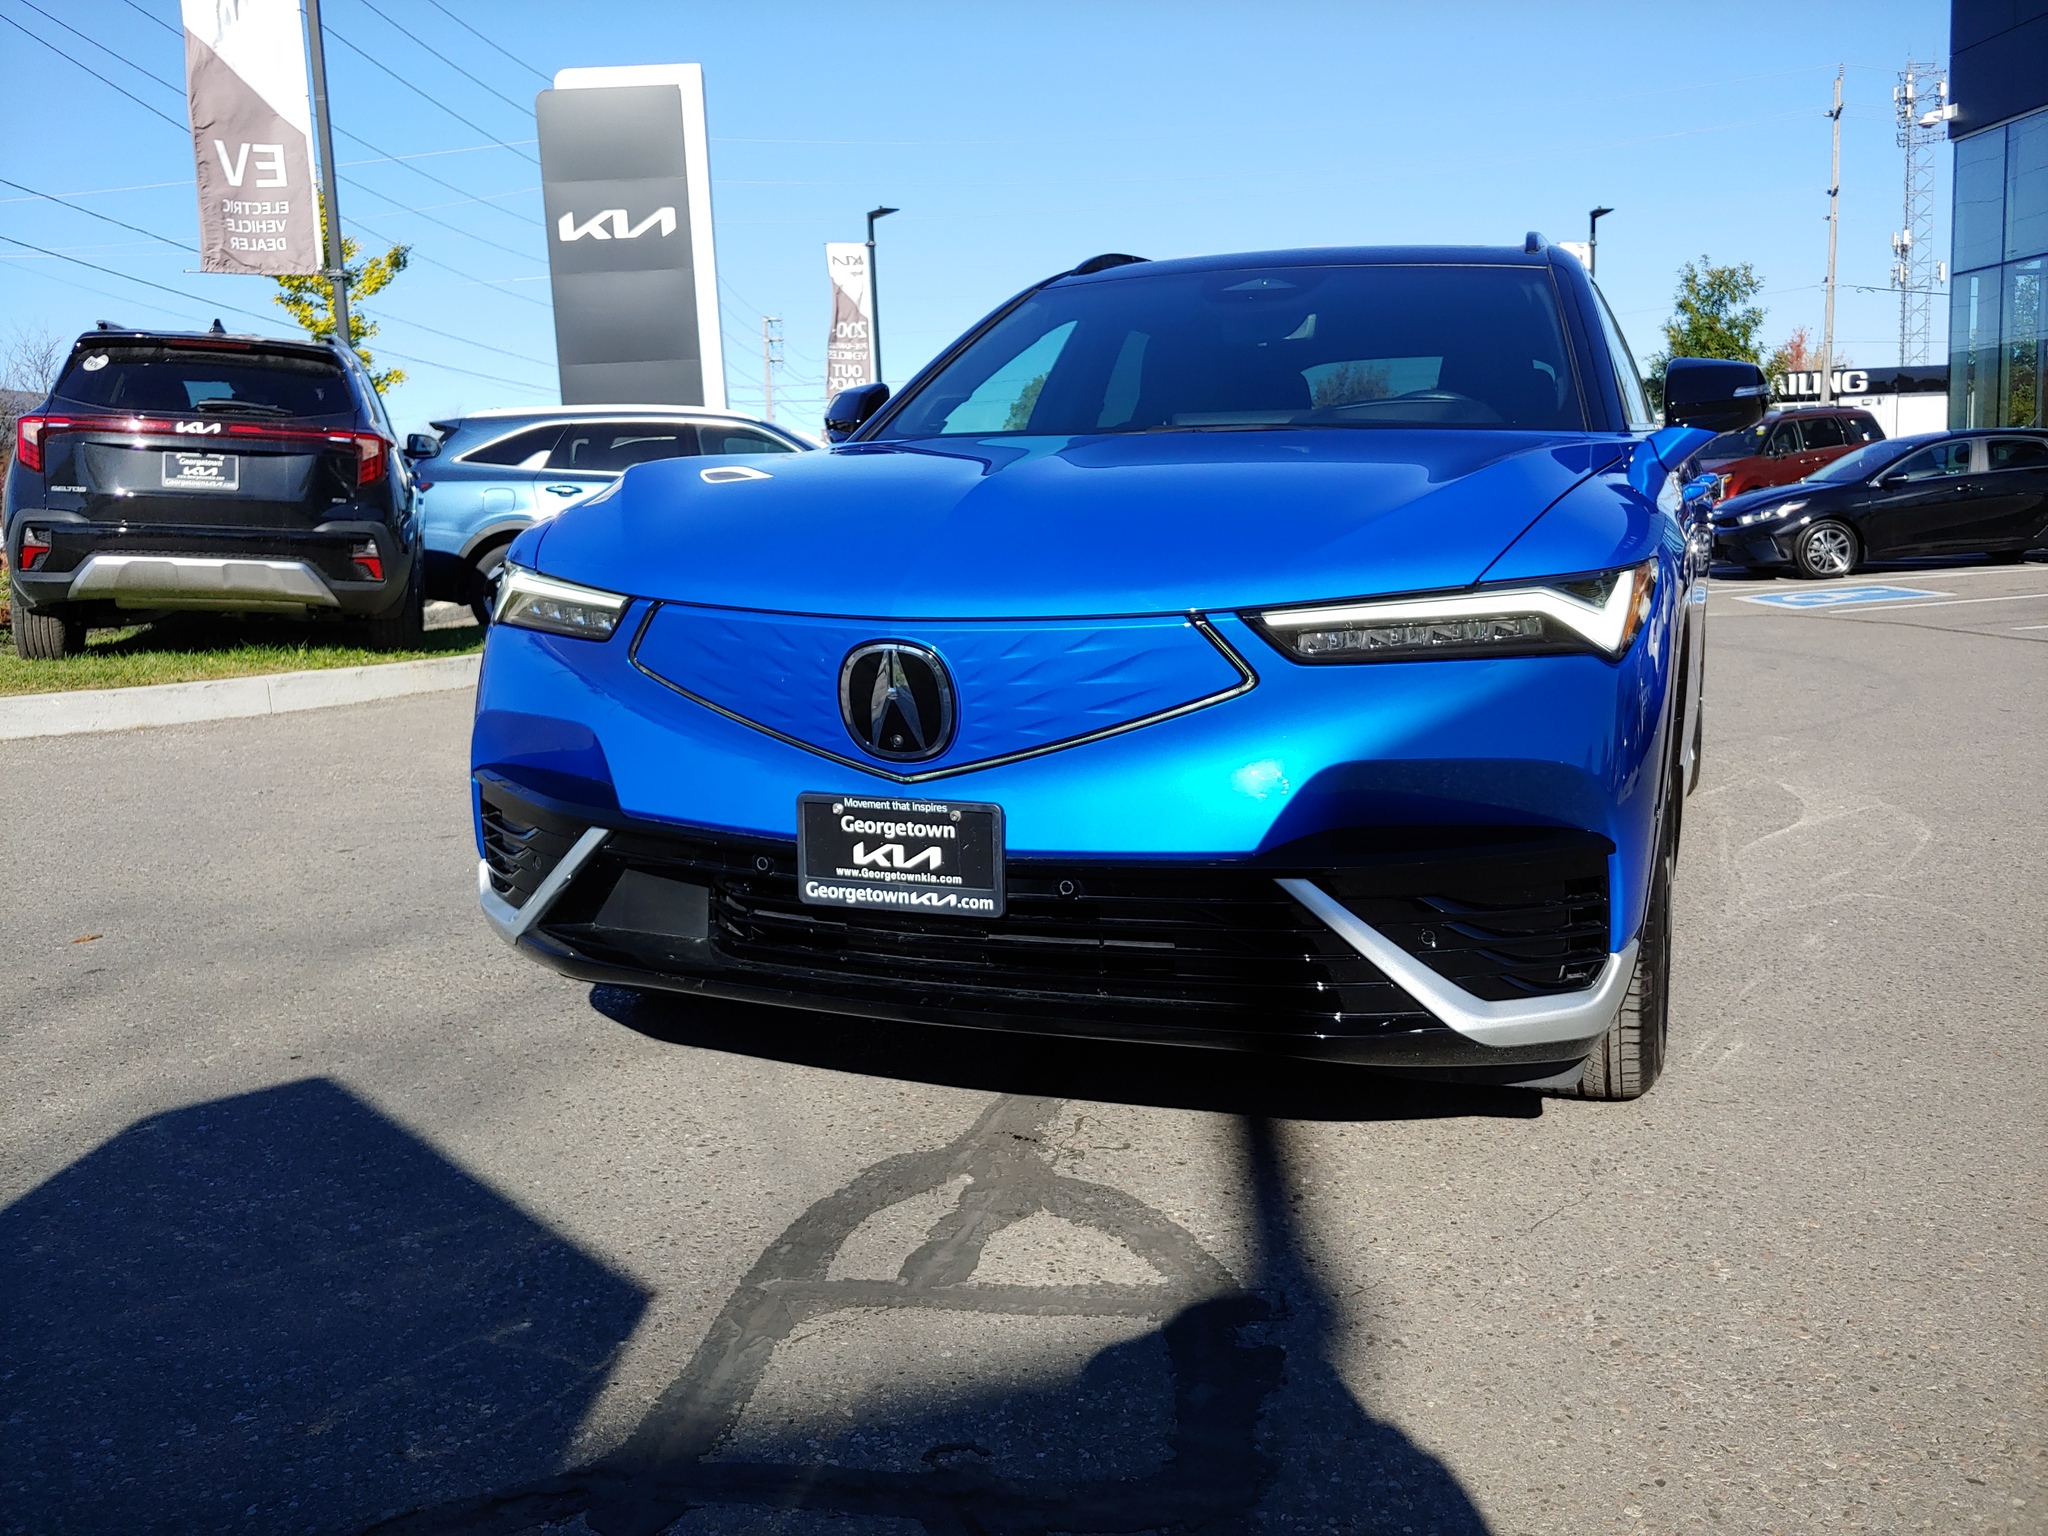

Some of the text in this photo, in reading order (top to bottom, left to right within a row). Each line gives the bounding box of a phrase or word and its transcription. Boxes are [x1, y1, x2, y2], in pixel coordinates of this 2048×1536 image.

[558, 206, 677, 242] KIA
[175, 421, 221, 434] KIA
[179, 458, 223, 467] Georgetown
[183, 466, 218, 476] KIA
[844, 797, 890, 810] Movement
[892, 801, 910, 811] that
[841, 815, 956, 839] Georgetown
[853, 841, 942, 870] KIA
